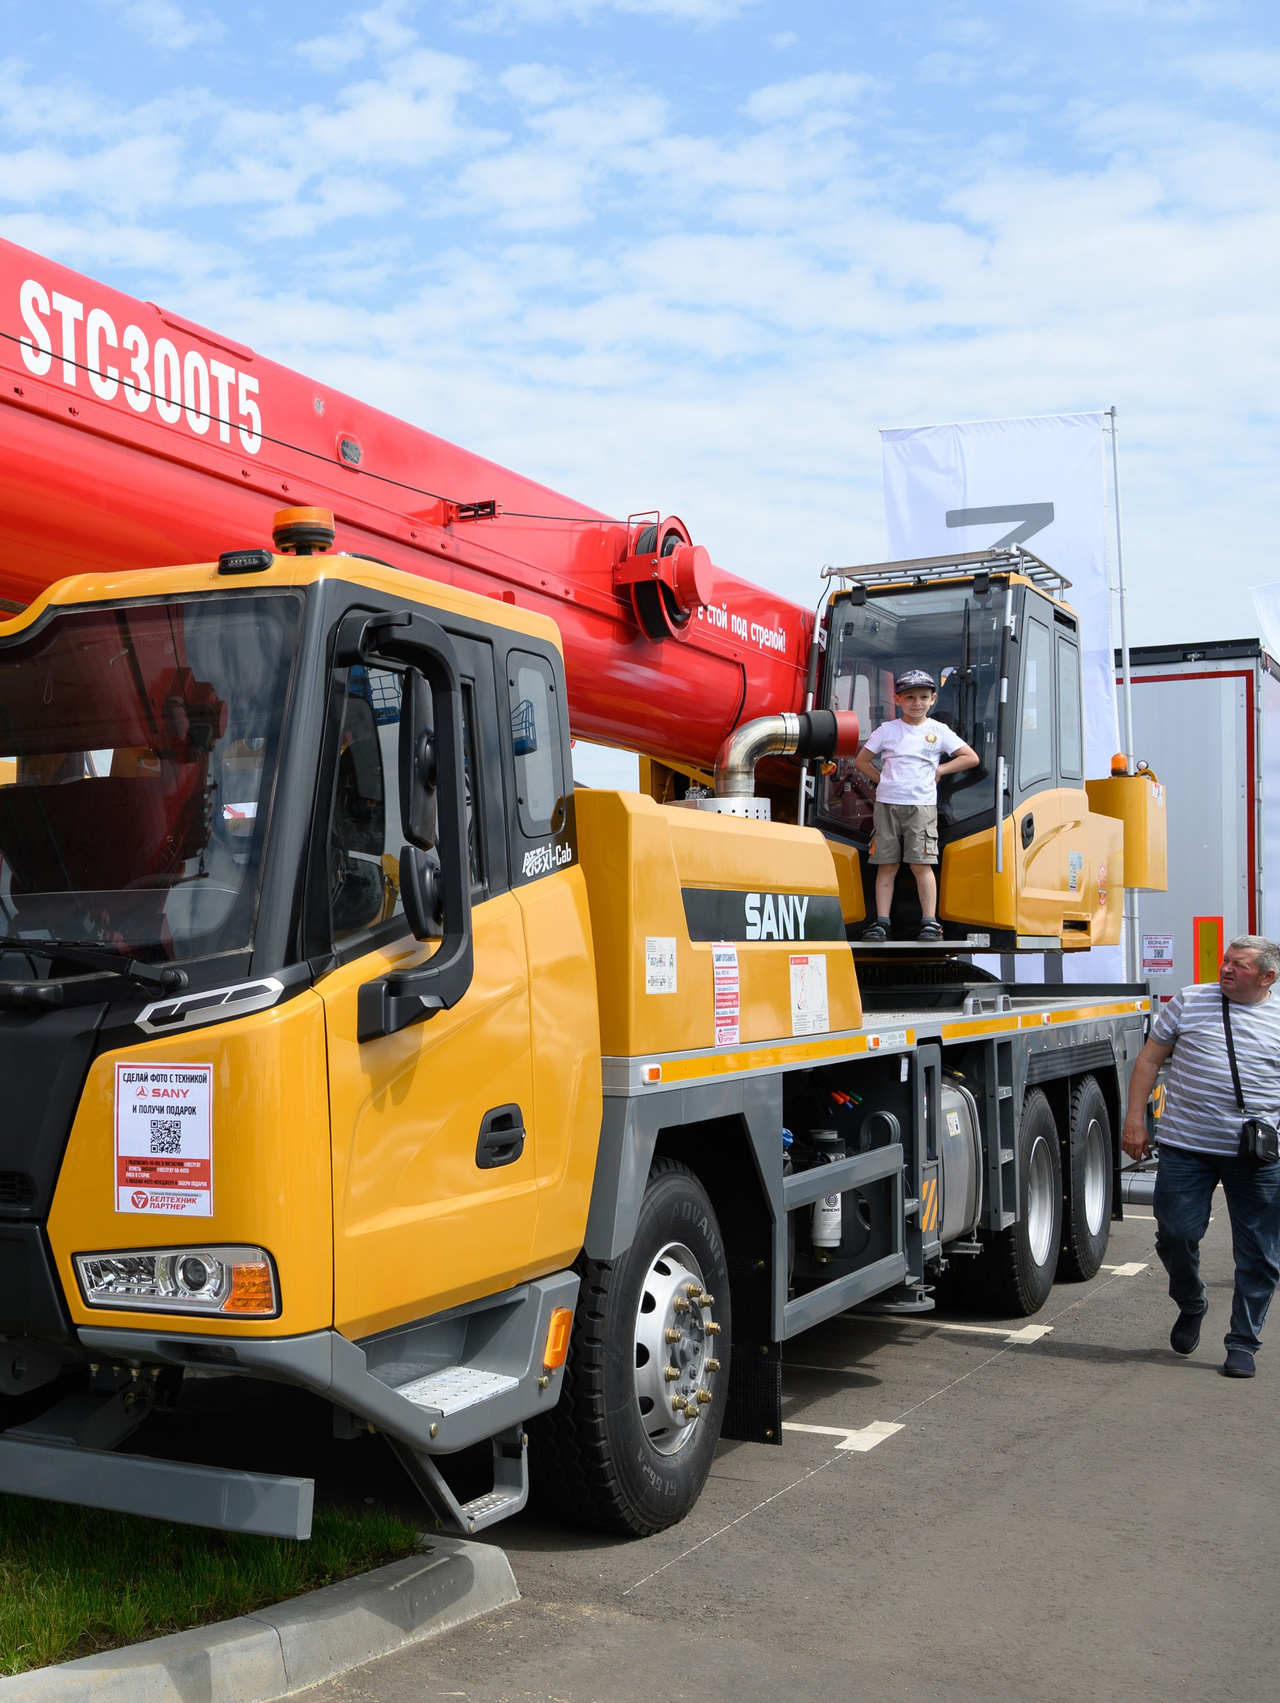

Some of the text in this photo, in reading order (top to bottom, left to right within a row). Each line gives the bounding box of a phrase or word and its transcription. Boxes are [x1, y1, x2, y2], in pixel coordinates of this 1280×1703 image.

[20, 279, 262, 454] STC300T5
[707, 603, 728, 630] стой
[731, 614, 748, 642] под
[750, 622, 786, 653] стрелой!
[745, 893, 809, 940] SANY
[122, 1072, 208, 1084] СДЕЛАЙ ФОТО С ТЕХНИКОЙ
[151, 1088, 190, 1098] SANY
[132, 1104, 197, 1116] И ПОЛУЧИ ПОДАРОК
[150, 1196, 197, 1204] БЕЛТЕХНИК
